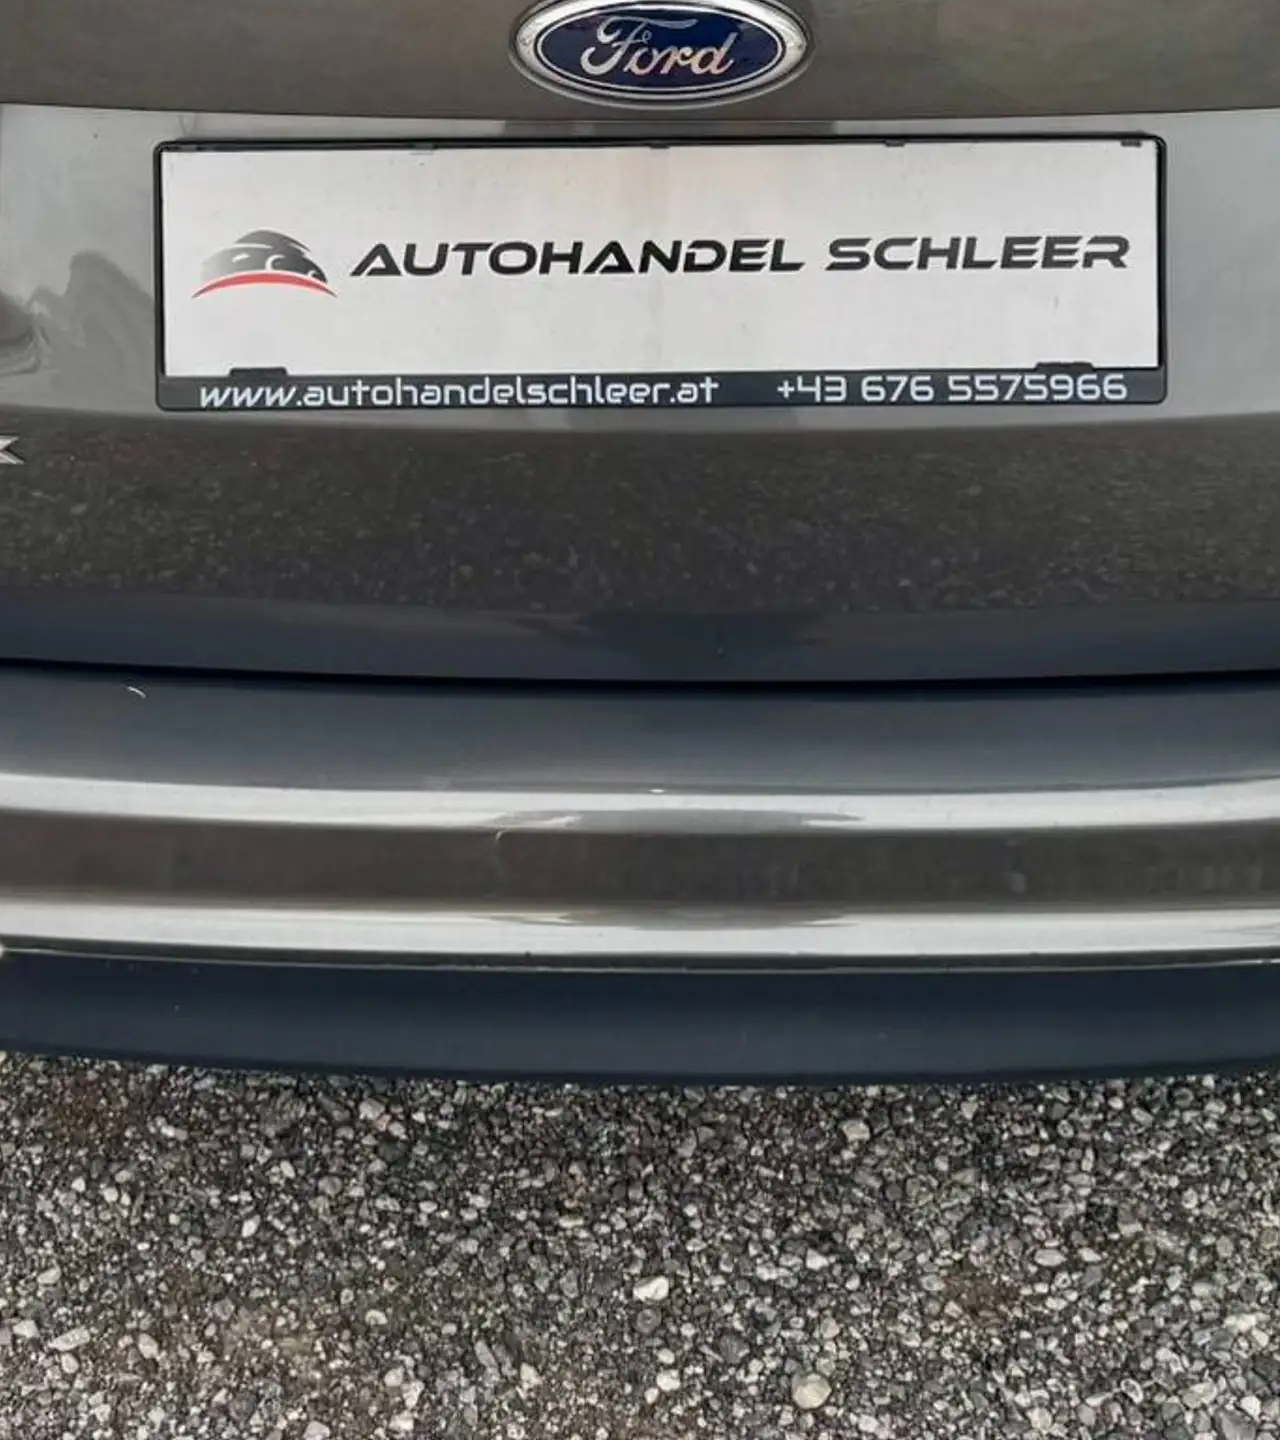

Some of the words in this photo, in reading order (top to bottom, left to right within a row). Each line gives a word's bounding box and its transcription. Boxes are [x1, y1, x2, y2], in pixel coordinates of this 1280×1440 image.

[580, 15, 738, 76] Ford
[350, 239, 804, 277] AUTOHANDEL
[826, 235, 1129, 271] SCHLEER
[200, 376, 719, 407] www.autohandelschleer.at
[777, 373, 847, 403] +43
[860, 373, 935, 403] 676
[947, 373, 1129, 402] 5575966
